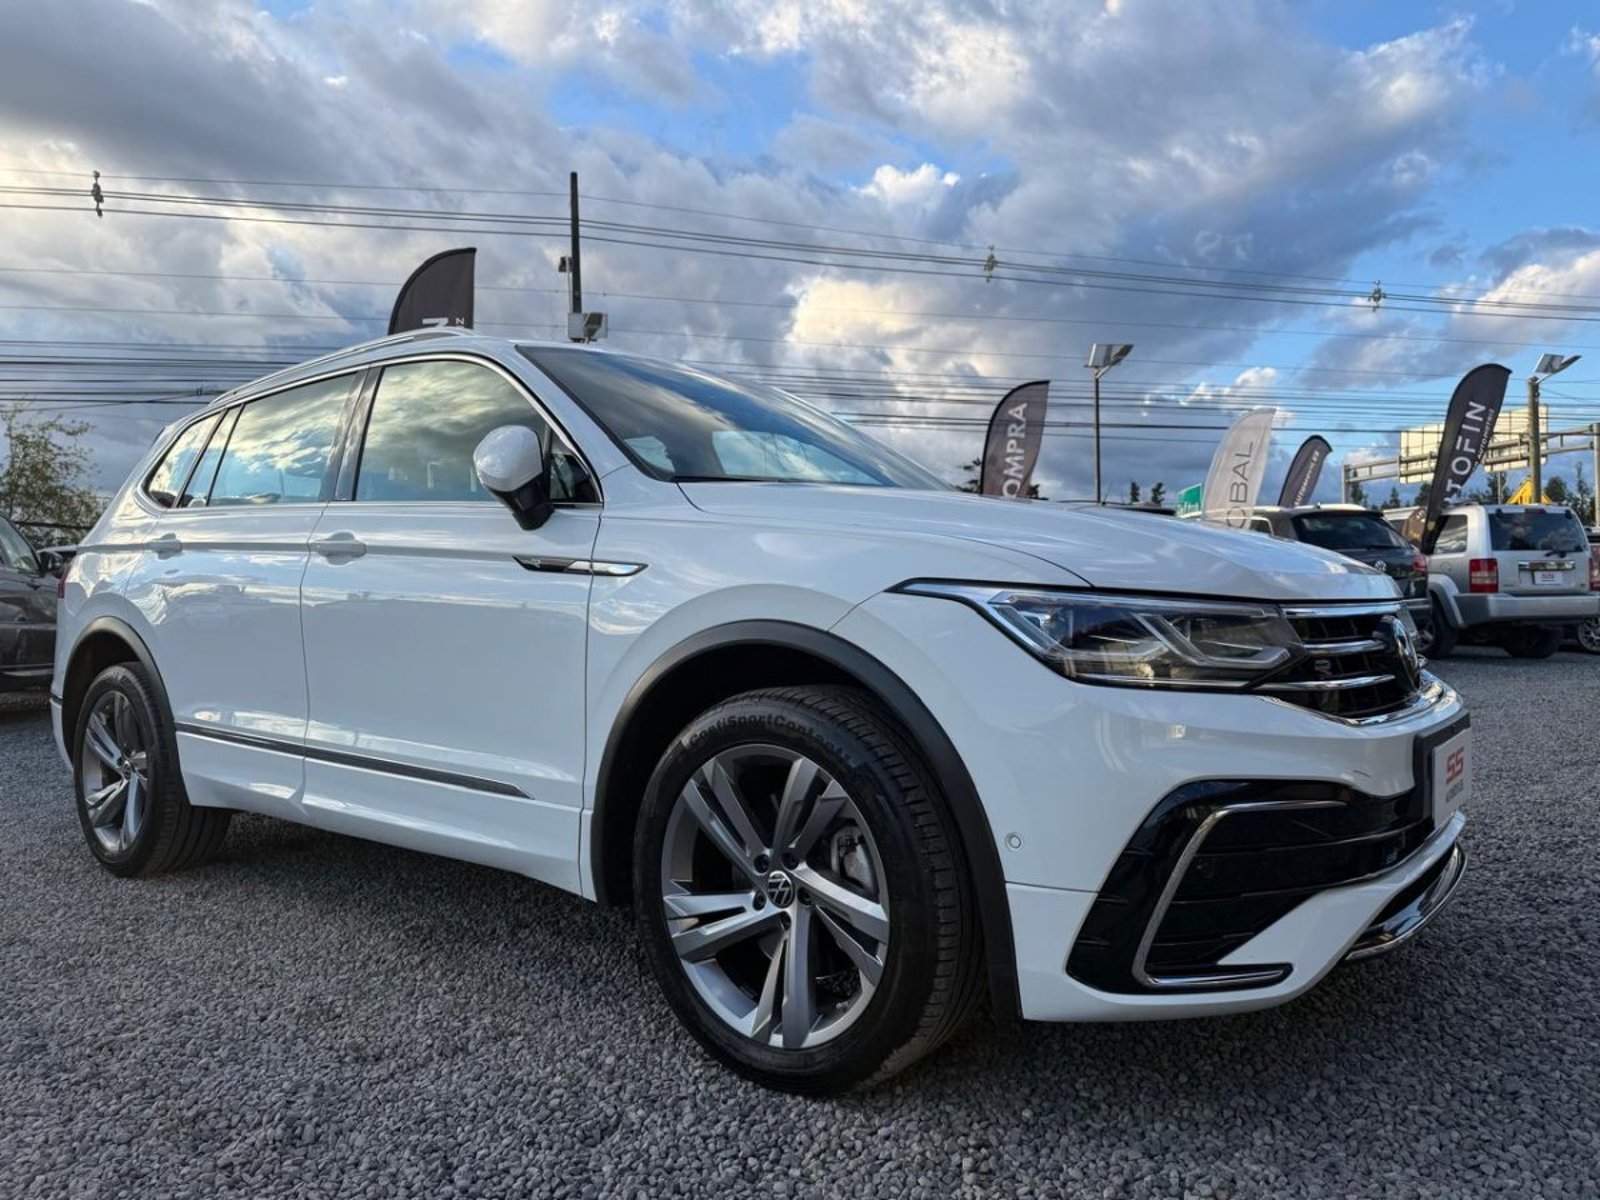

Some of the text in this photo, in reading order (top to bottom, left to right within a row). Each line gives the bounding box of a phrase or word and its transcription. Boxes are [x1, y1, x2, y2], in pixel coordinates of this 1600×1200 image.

[1002, 402, 1028, 498] OMPRA
[1226, 442, 1254, 529] OBAL
[1444, 401, 1487, 502] TOFIN
